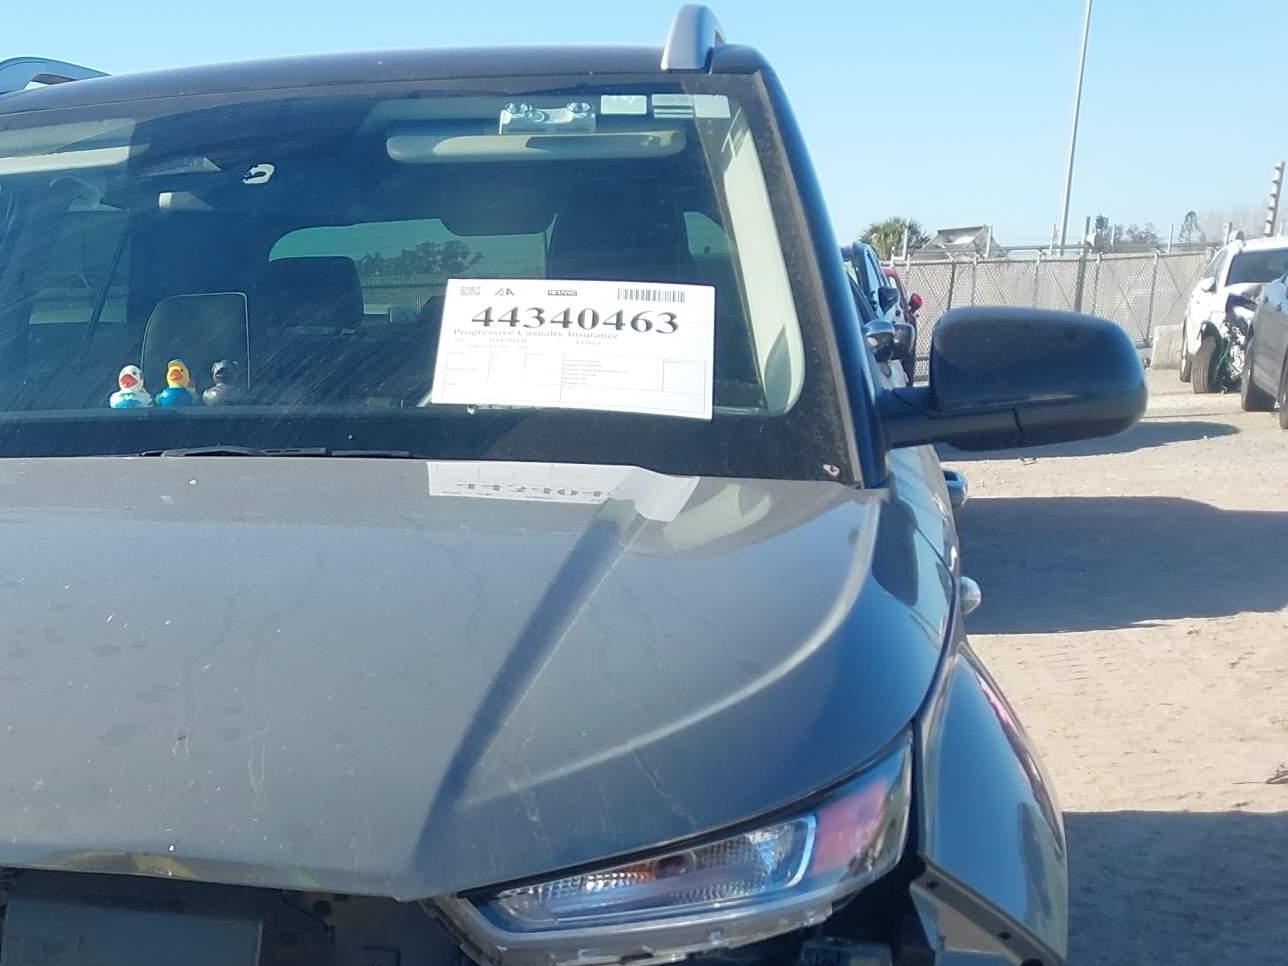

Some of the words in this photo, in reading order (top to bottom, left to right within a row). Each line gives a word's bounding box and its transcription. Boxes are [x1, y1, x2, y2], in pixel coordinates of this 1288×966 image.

[472, 305, 680, 334] 44340463
[453, 328, 514, 338] Progressive
[568, 330, 619, 339] Insurance
